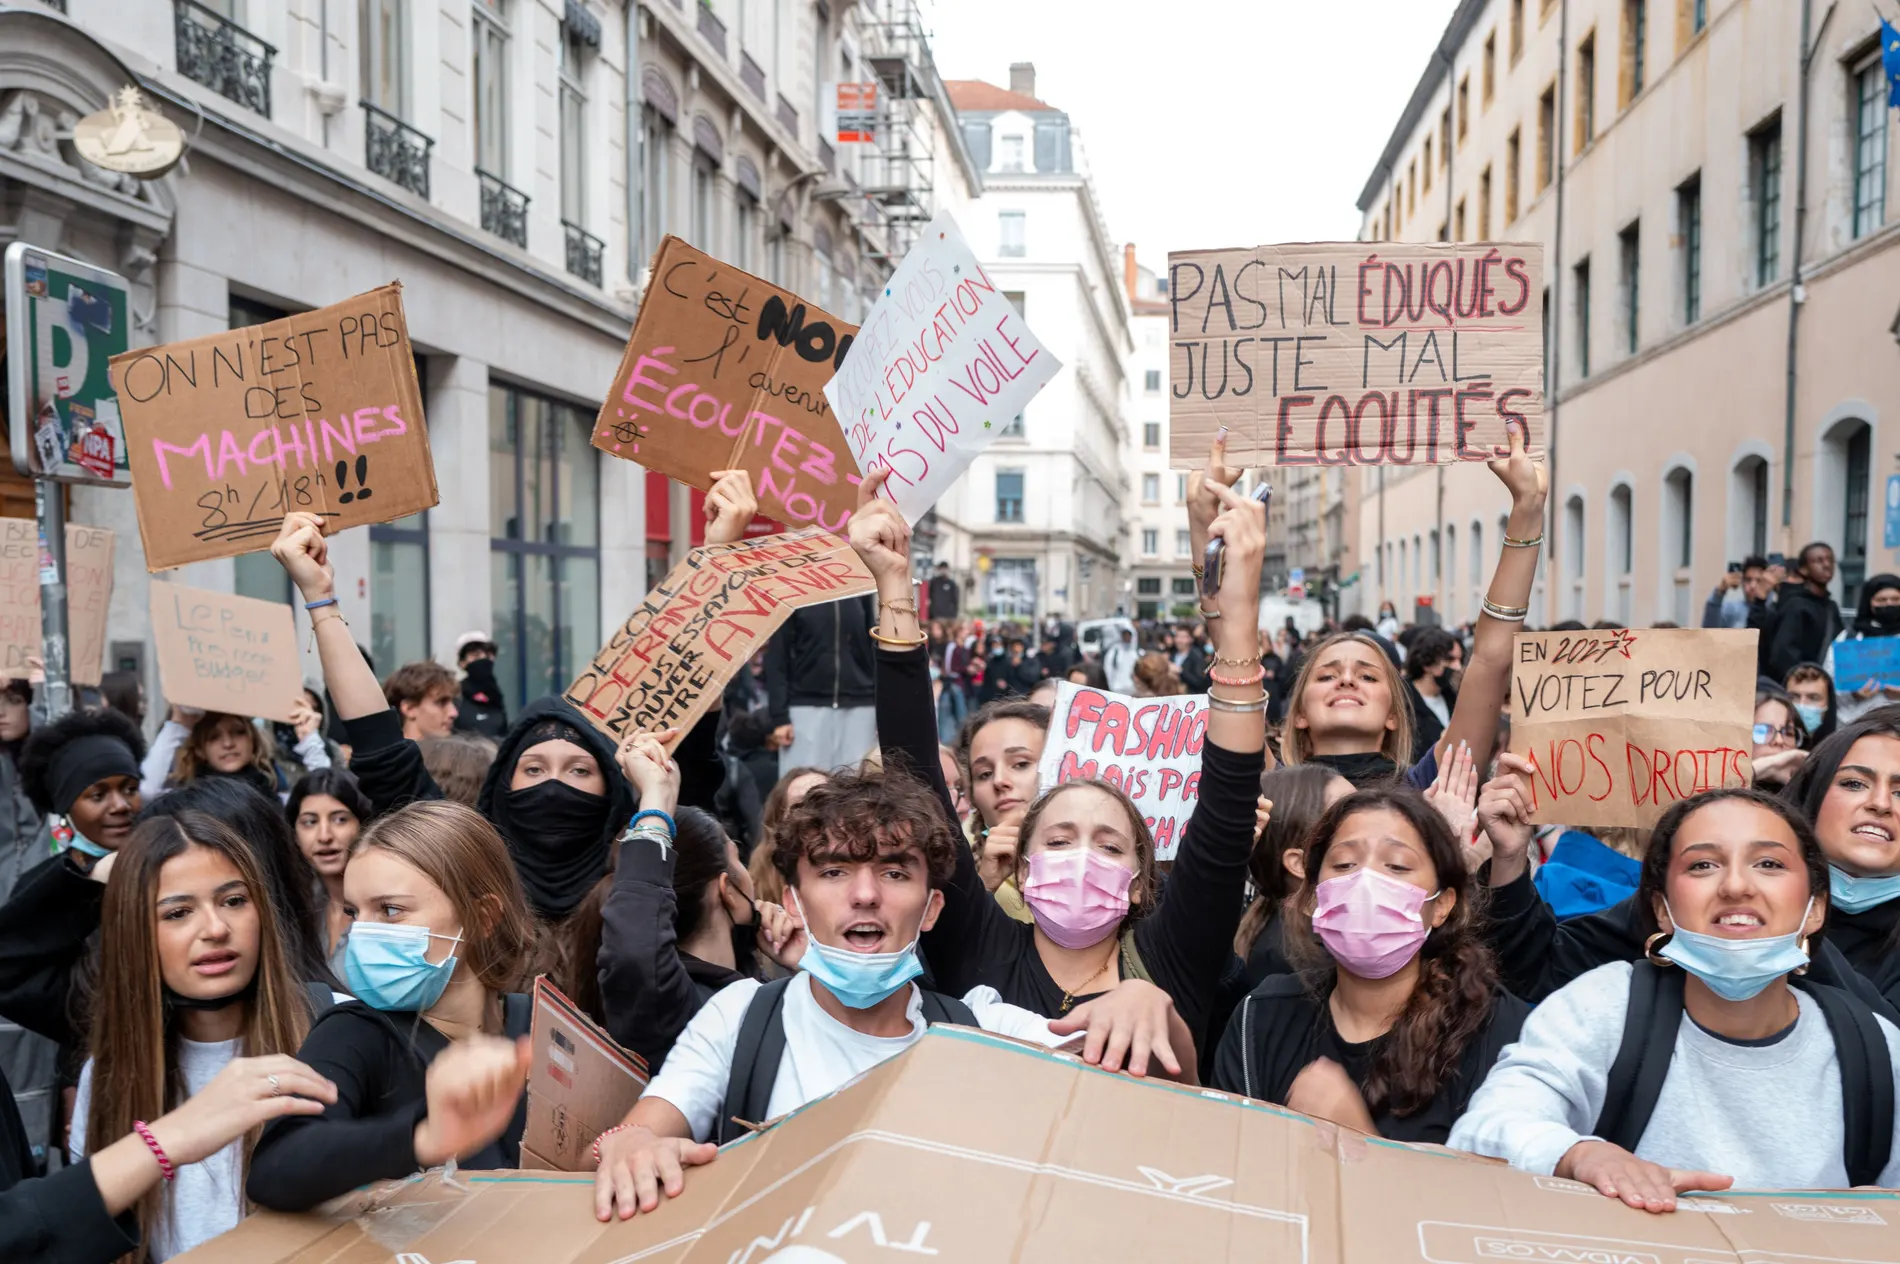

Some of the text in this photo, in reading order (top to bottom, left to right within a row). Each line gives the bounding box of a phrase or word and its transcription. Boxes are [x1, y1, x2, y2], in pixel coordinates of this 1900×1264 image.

[664, 261, 855, 373] C'est NO
[1169, 247, 1531, 333] PAS MAL ÉDUQUÉS
[124, 311, 400, 402] ON N'EST PAS
[912, 394, 960, 453] DU
[948, 314, 1039, 406] VOILE
[1173, 329, 1491, 400] JUSTE MAL
[244, 382, 322, 419] DES
[851, 408, 877, 461] DE
[152, 404, 407, 490] MACHINES
[758, 467, 852, 533] NOU
[607, 551, 832, 733] NOUS ESSAYONS DE
[704, 561, 870, 663] AVENIR
[1520, 637, 1620, 665] EN 2027
[1517, 669, 1712, 717] VOTEZ POUR
[1158, 767, 1203, 801] PA
[1528, 733, 1749, 811] NOS DROITS
[1485, 1241, 1535, 1256] OS
